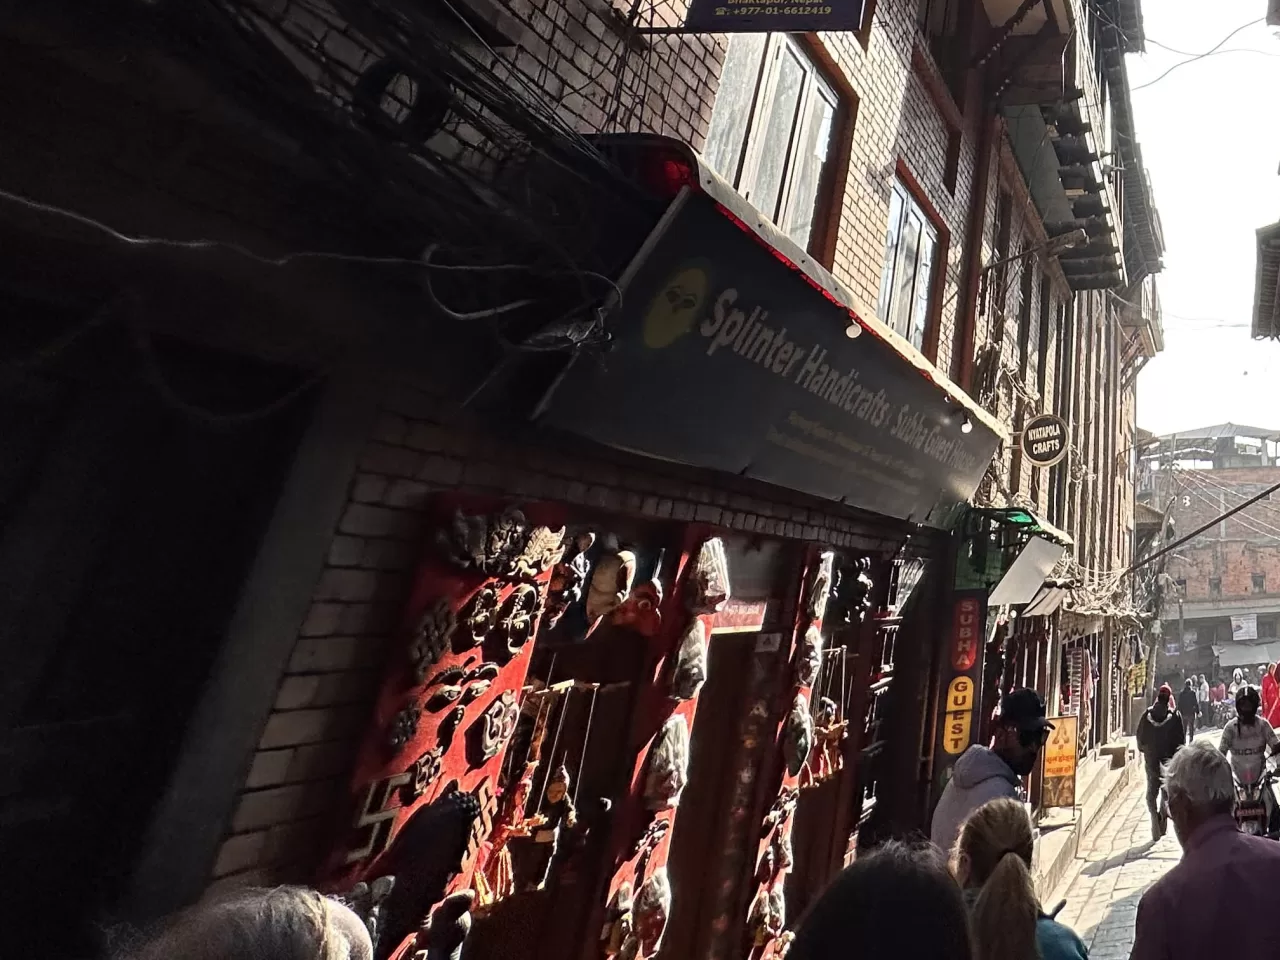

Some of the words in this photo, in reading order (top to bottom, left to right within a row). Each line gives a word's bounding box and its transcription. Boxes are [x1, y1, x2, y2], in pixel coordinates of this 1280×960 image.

[700, 287, 805, 378] Splinter
[796, 344, 889, 428] Handicrafts
[1028, 423, 1061, 441] NYATAPOLA
[1032, 439, 1060, 455] CRAFTS
[955, 601, 975, 665] SUBHA
[950, 681, 968, 749] GUEST
